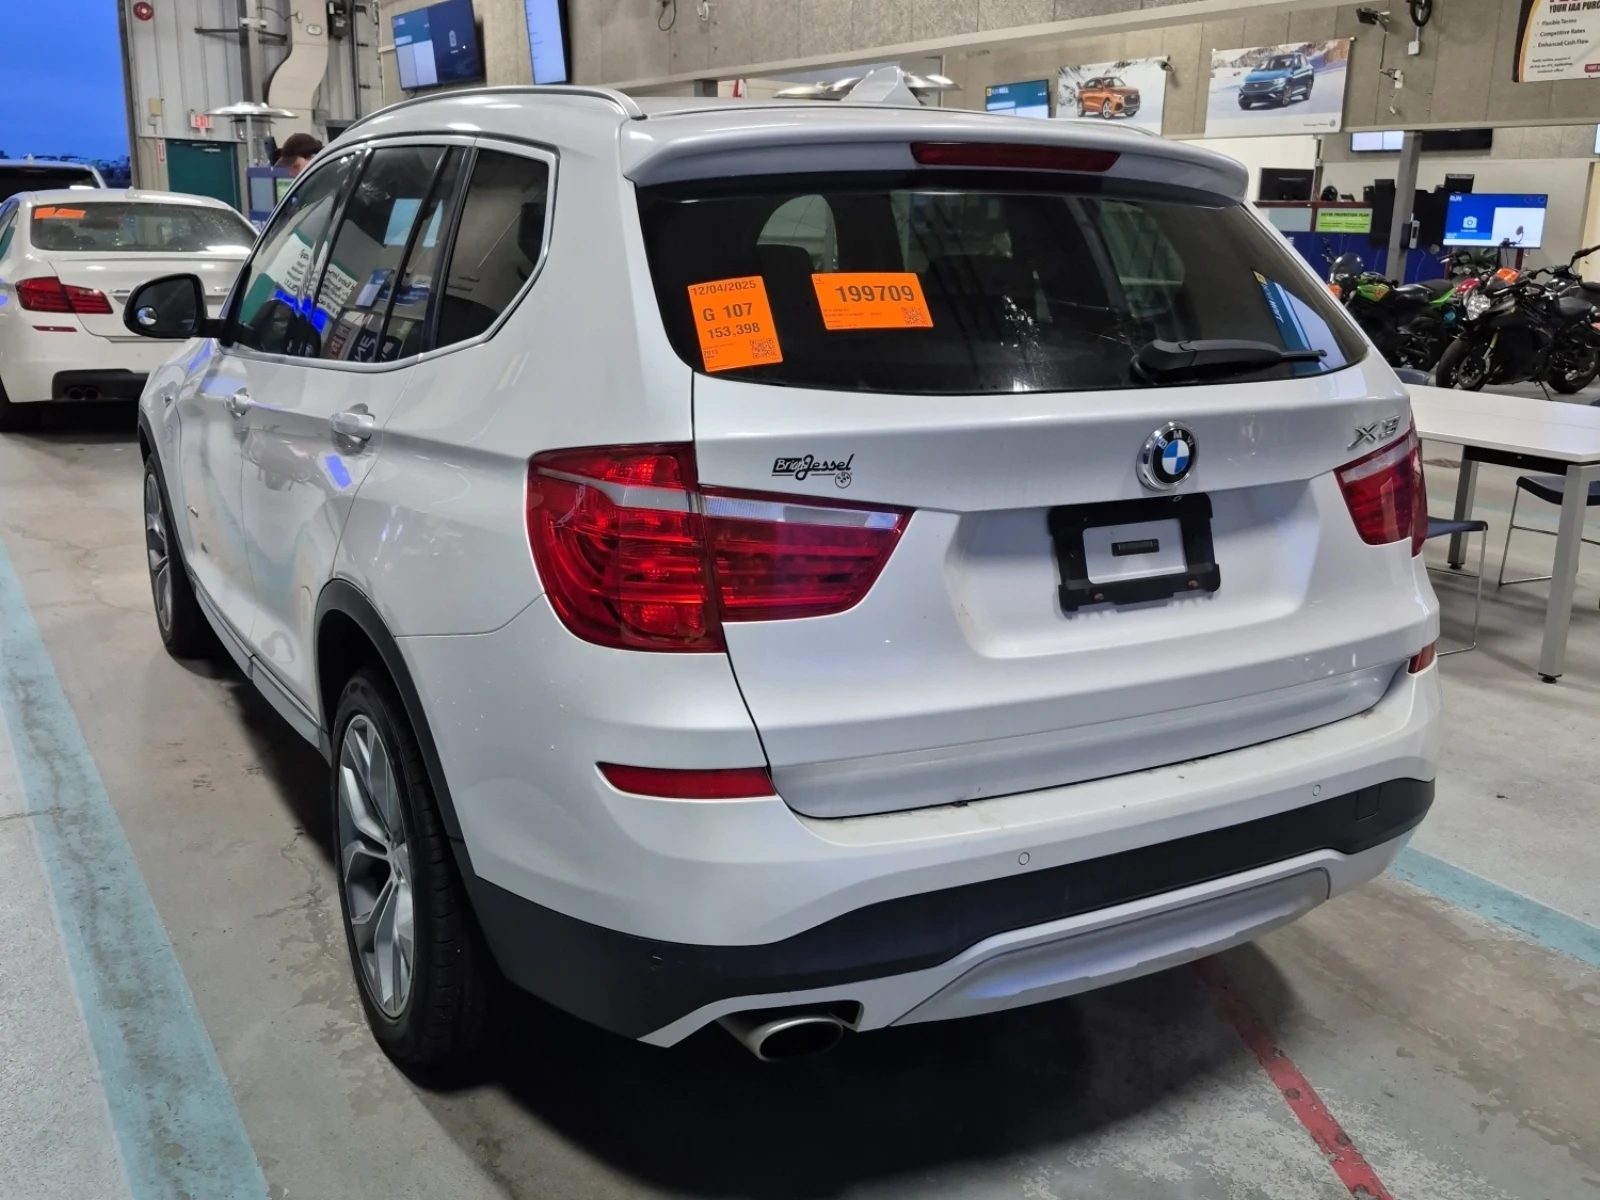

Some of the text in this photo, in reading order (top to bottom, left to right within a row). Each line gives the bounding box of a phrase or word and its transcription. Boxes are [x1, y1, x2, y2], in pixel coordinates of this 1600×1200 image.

[1549, 4, 1567, 13] YOUR
[1568, 3, 1580, 12] IAA
[692, 280, 757, 296] 12/04/2025
[835, 285, 915, 303] 199709
[702, 302, 753, 322] G 107
[707, 322, 760, 339] 153,398
[1157, 429, 1195, 450] BMW
[1346, 415, 1401, 452] X3
[795, 453, 855, 481] Jessel
